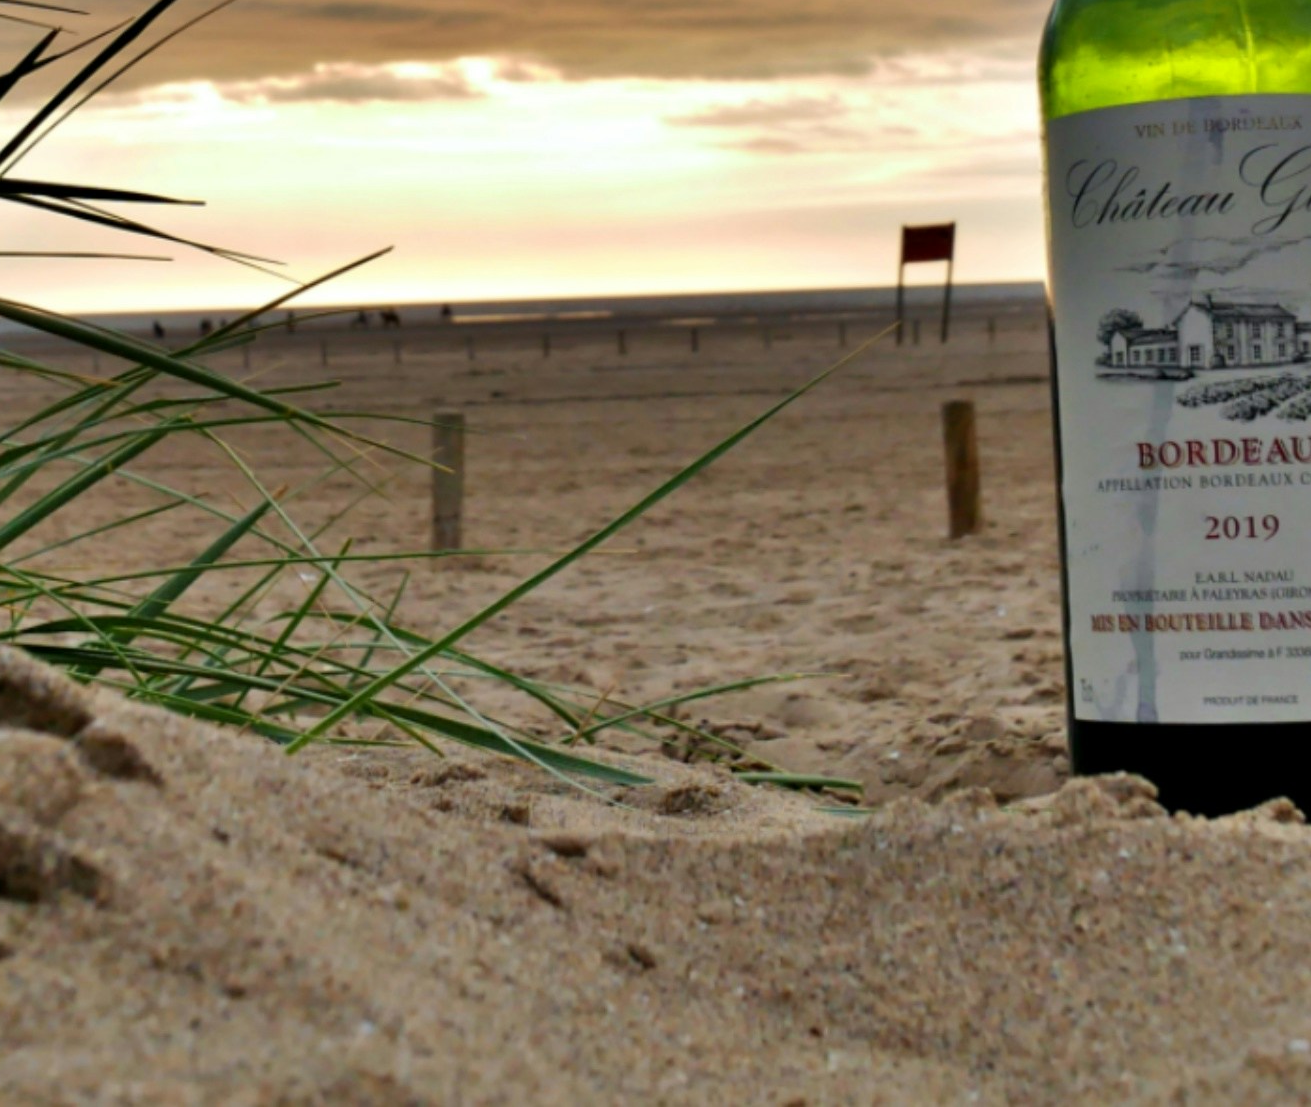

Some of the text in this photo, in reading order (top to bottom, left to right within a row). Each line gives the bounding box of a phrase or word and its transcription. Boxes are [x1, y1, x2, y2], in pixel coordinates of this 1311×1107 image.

[1134, 114, 1303, 138] VIN DE BORDEAUX
[1067, 158, 1236, 229] Château
[1096, 475, 1192, 493] APPELLATION
[1199, 472, 1293, 489] BORDEAUX
[1204, 515, 1280, 541] 2019
[1090, 613, 1115, 633] MIS
[1118, 613, 1140, 632] EN
[1144, 611, 1254, 632] BOUTEILLE
